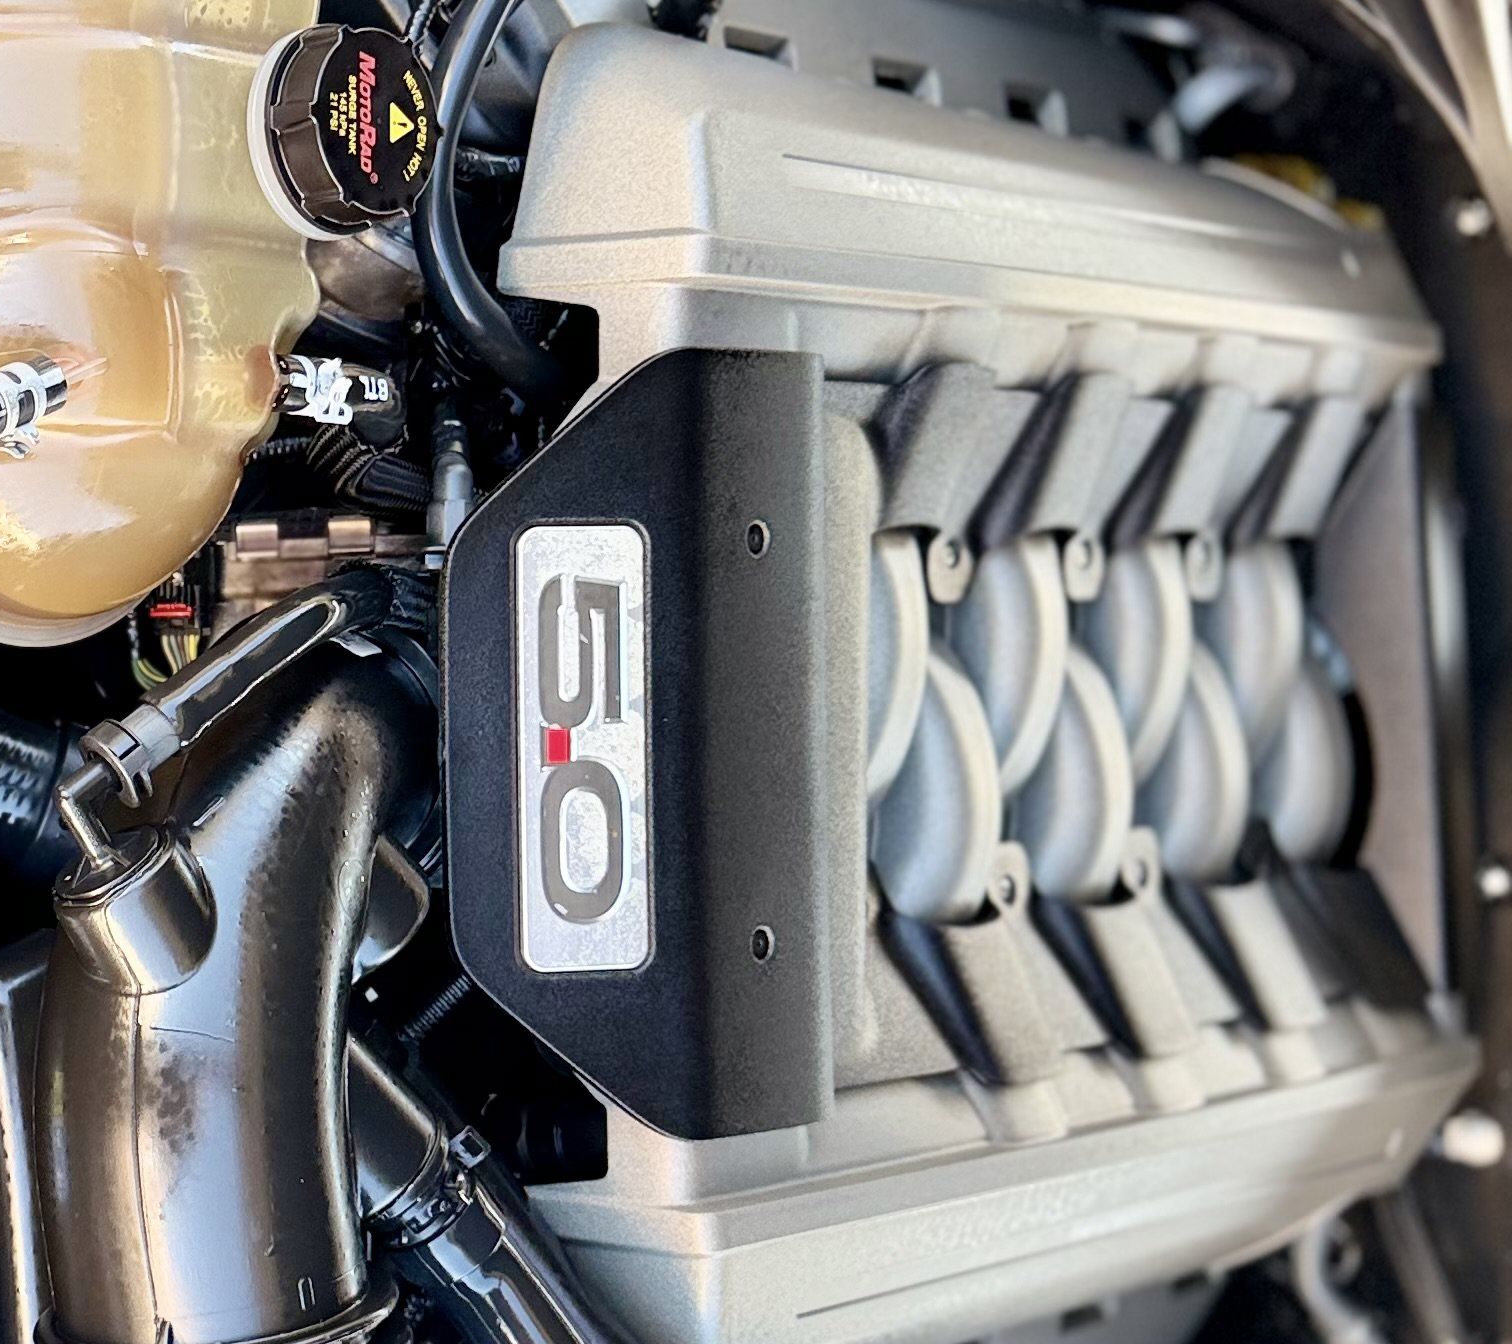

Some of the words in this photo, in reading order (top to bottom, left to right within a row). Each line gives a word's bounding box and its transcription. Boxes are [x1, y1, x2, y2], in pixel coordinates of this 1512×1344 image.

[329, 92, 338, 107] 21
[338, 92, 347, 112] 145
[347, 74, 357, 120] SURGE
[402, 70, 425, 111] NEVER
[415, 115, 427, 151] OPEN
[347, 123, 357, 155] TANK
[538, 574, 630, 925] 5.0
